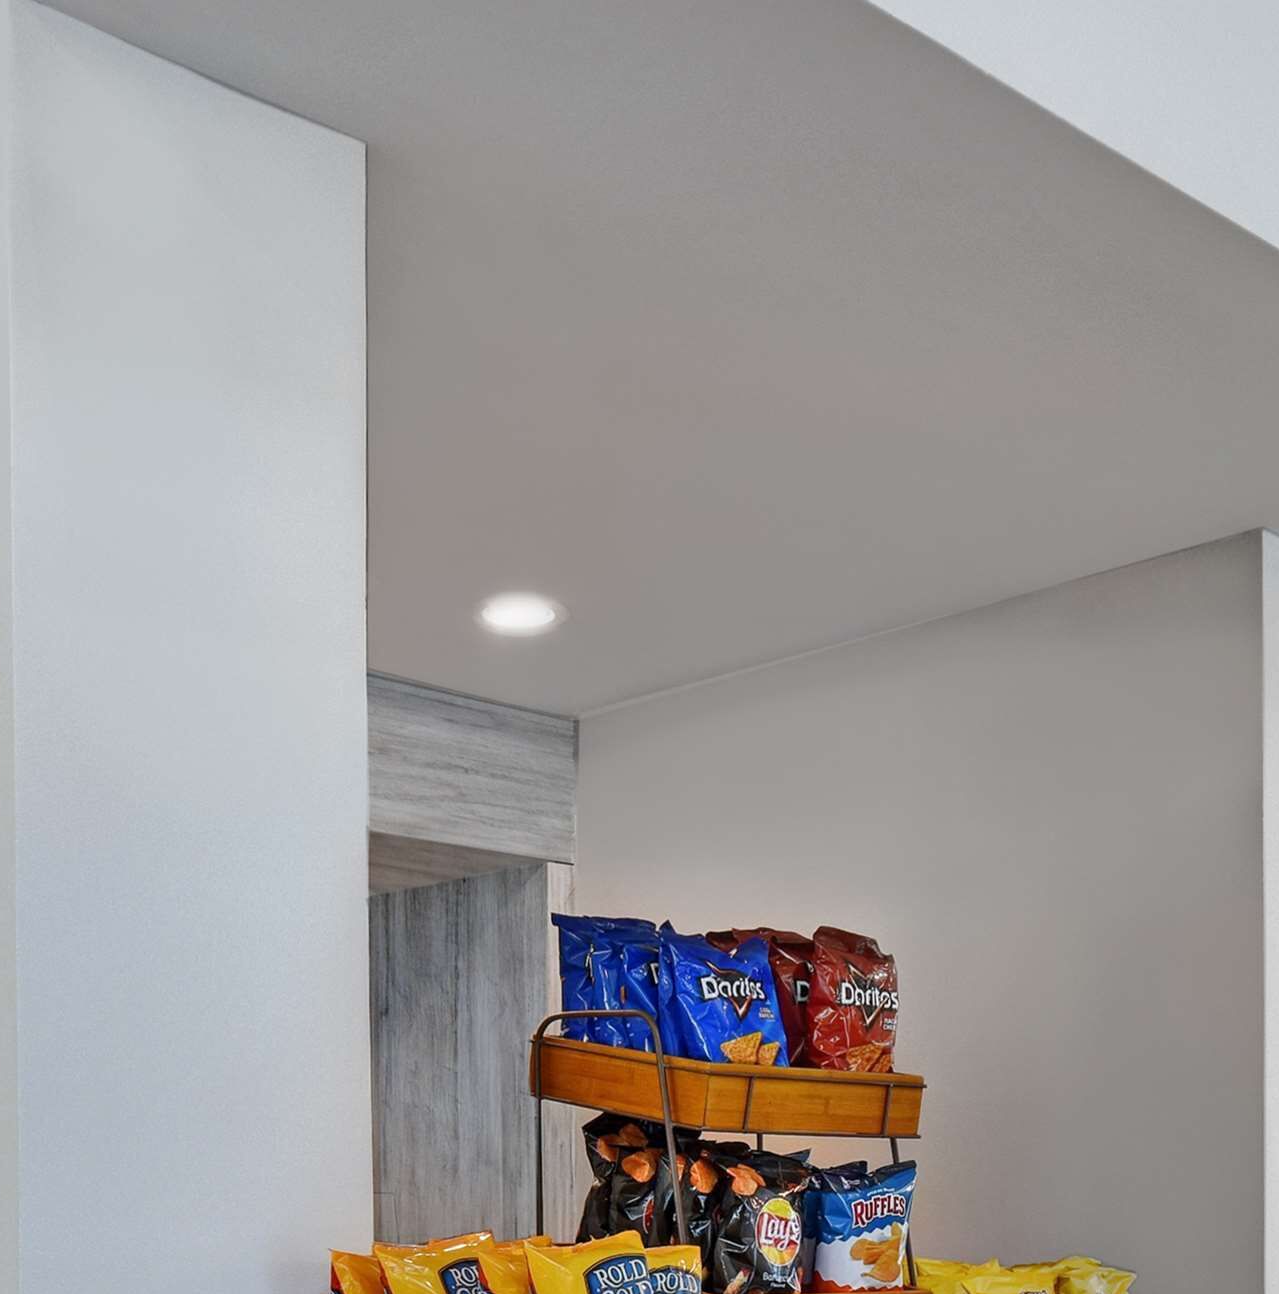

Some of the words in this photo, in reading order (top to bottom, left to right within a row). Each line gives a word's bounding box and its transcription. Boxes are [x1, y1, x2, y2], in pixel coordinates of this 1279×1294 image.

[701, 976, 766, 1001] Doritos
[841, 981, 898, 1010] Doritos
[852, 1194, 906, 1228] RUFFLES
[760, 1212, 801, 1250] Lay's
[594, 1259, 647, 1288] ROLD
[654, 1272, 698, 1294] ROLD
